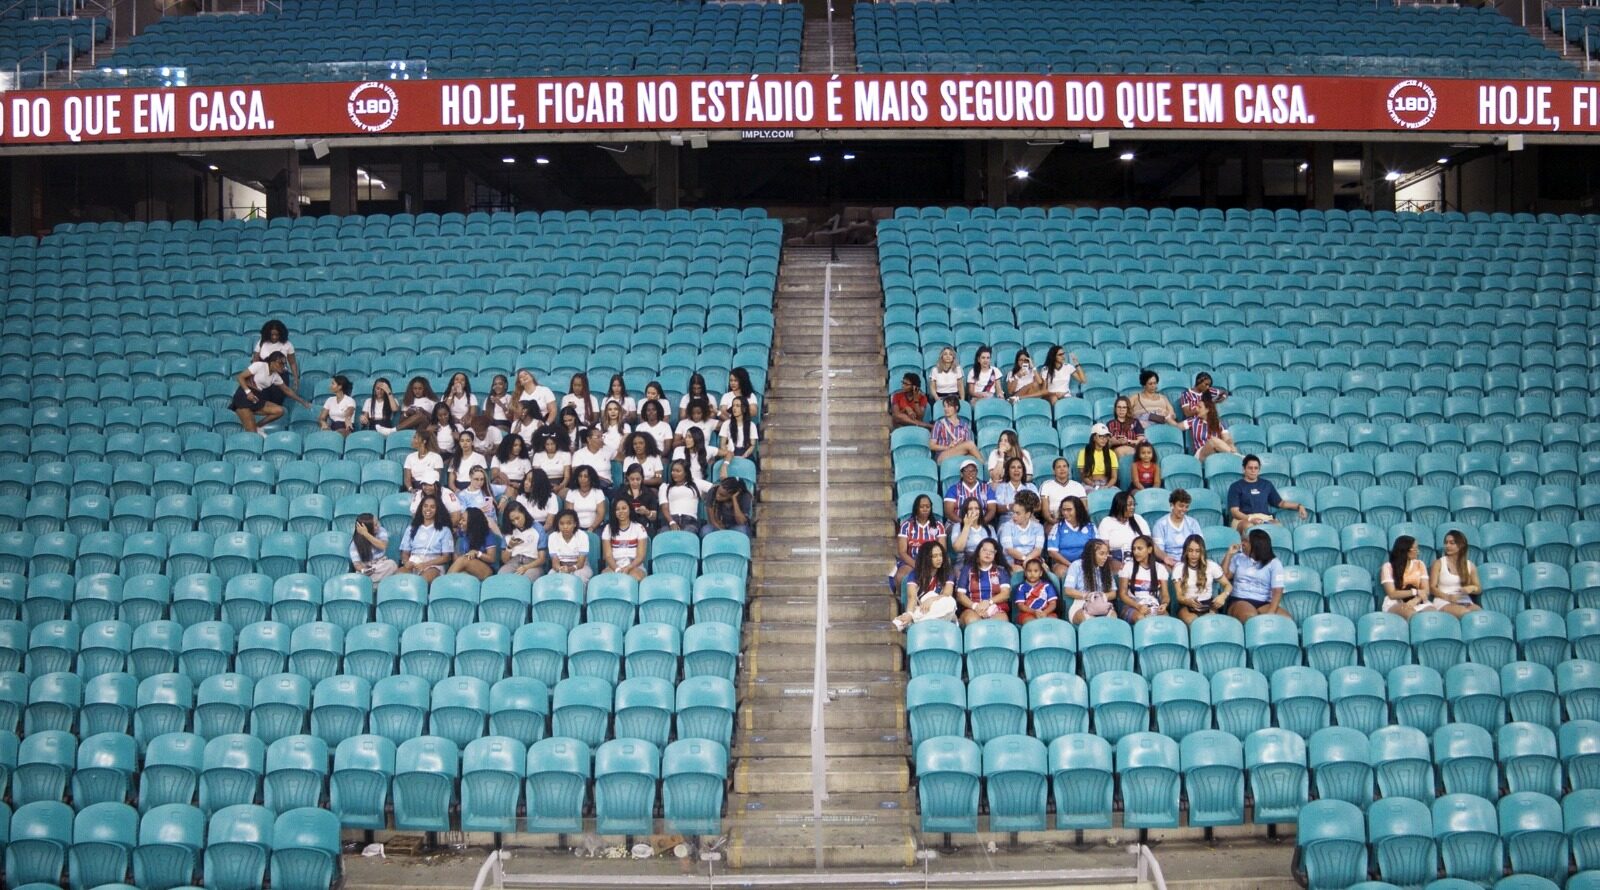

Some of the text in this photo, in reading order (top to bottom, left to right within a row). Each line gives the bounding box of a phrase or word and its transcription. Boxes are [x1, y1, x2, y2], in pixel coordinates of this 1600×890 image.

[13, 97, 51, 138] DO
[64, 94, 122, 142] QUE
[133, 92, 175, 134] EM
[189, 90, 275, 132] CASA.
[355, 99, 391, 114] 180
[441, 73, 1316, 130] HOJE, FICAR NO ESTÁDIO É MAIS SEGURO DO QUE EM CASA.
[1394, 96, 1429, 111] 180
[1478, 85, 1560, 132] HOJE,
[742, 130, 794, 138] IMPLY.COM
